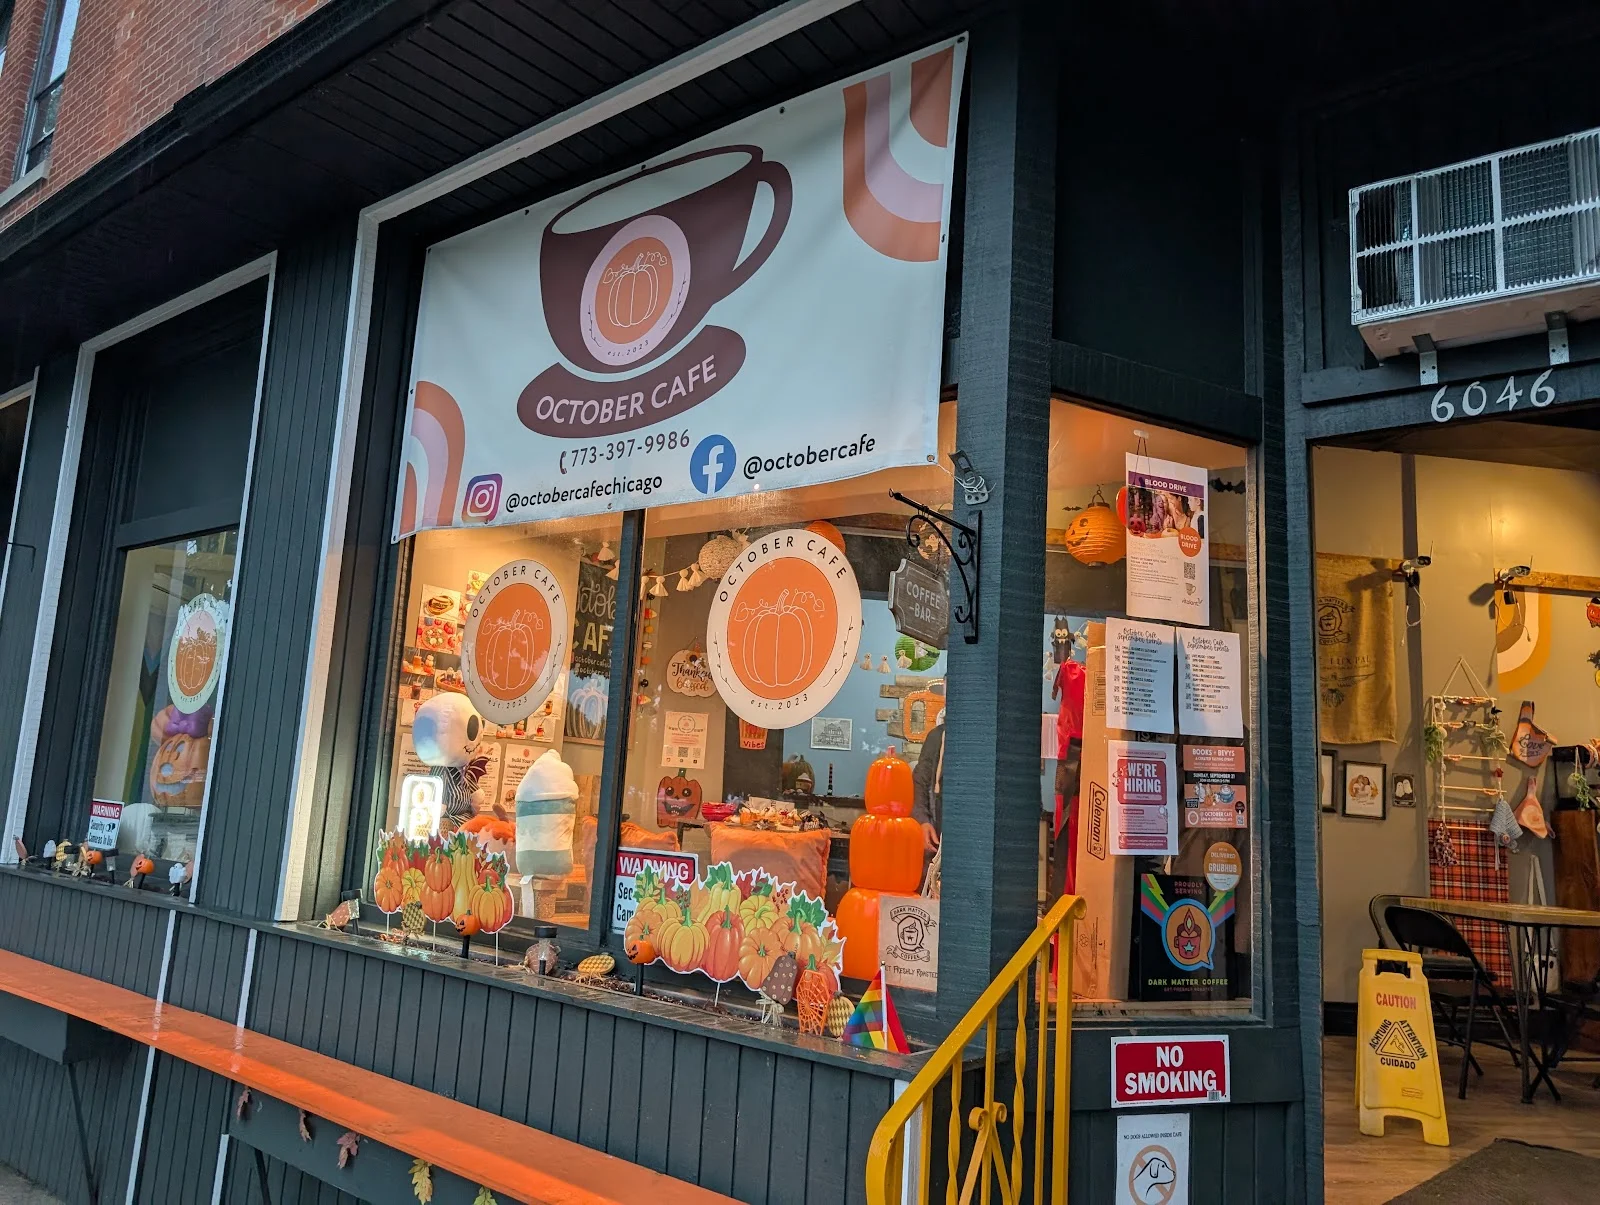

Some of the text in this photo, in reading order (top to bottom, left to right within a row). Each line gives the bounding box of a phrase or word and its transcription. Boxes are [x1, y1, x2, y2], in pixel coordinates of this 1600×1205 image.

[536, 355, 718, 425] OCTOBER CAFE
[1431, 368, 1556, 422] 6046
[571, 429, 690, 467] 773-397-9986
[744, 434, 876, 479] @octobercafe
[506, 476, 662, 512] @octobercafechicago
[1145, 478, 1187, 493] BLOOD DRIVE
[720, 536, 846, 602] OCTOBER CAFE
[473, 565, 560, 618] OCTOBER CAFE
[907, 581, 940, 610] COFFEE
[1128, 762, 1157, 778] WE'RE
[1124, 778, 1161, 792] HIRING
[92, 804, 120, 818] WARNING
[1093, 790, 1105, 842] Coleman
[1208, 863, 1237, 873] GRUBHUB
[908, 908, 927, 918] MATTER
[893, 966, 915, 974] FRESHLY
[1376, 992, 1417, 1009] CAUTION
[1369, 1019, 1392, 1050] ACHTUNG
[1399, 1019, 1428, 1059] ATTENTION
[1156, 1046, 1184, 1068] NO
[1380, 1057, 1416, 1070] CUIDADO
[1124, 1070, 1217, 1095] SMOKING
